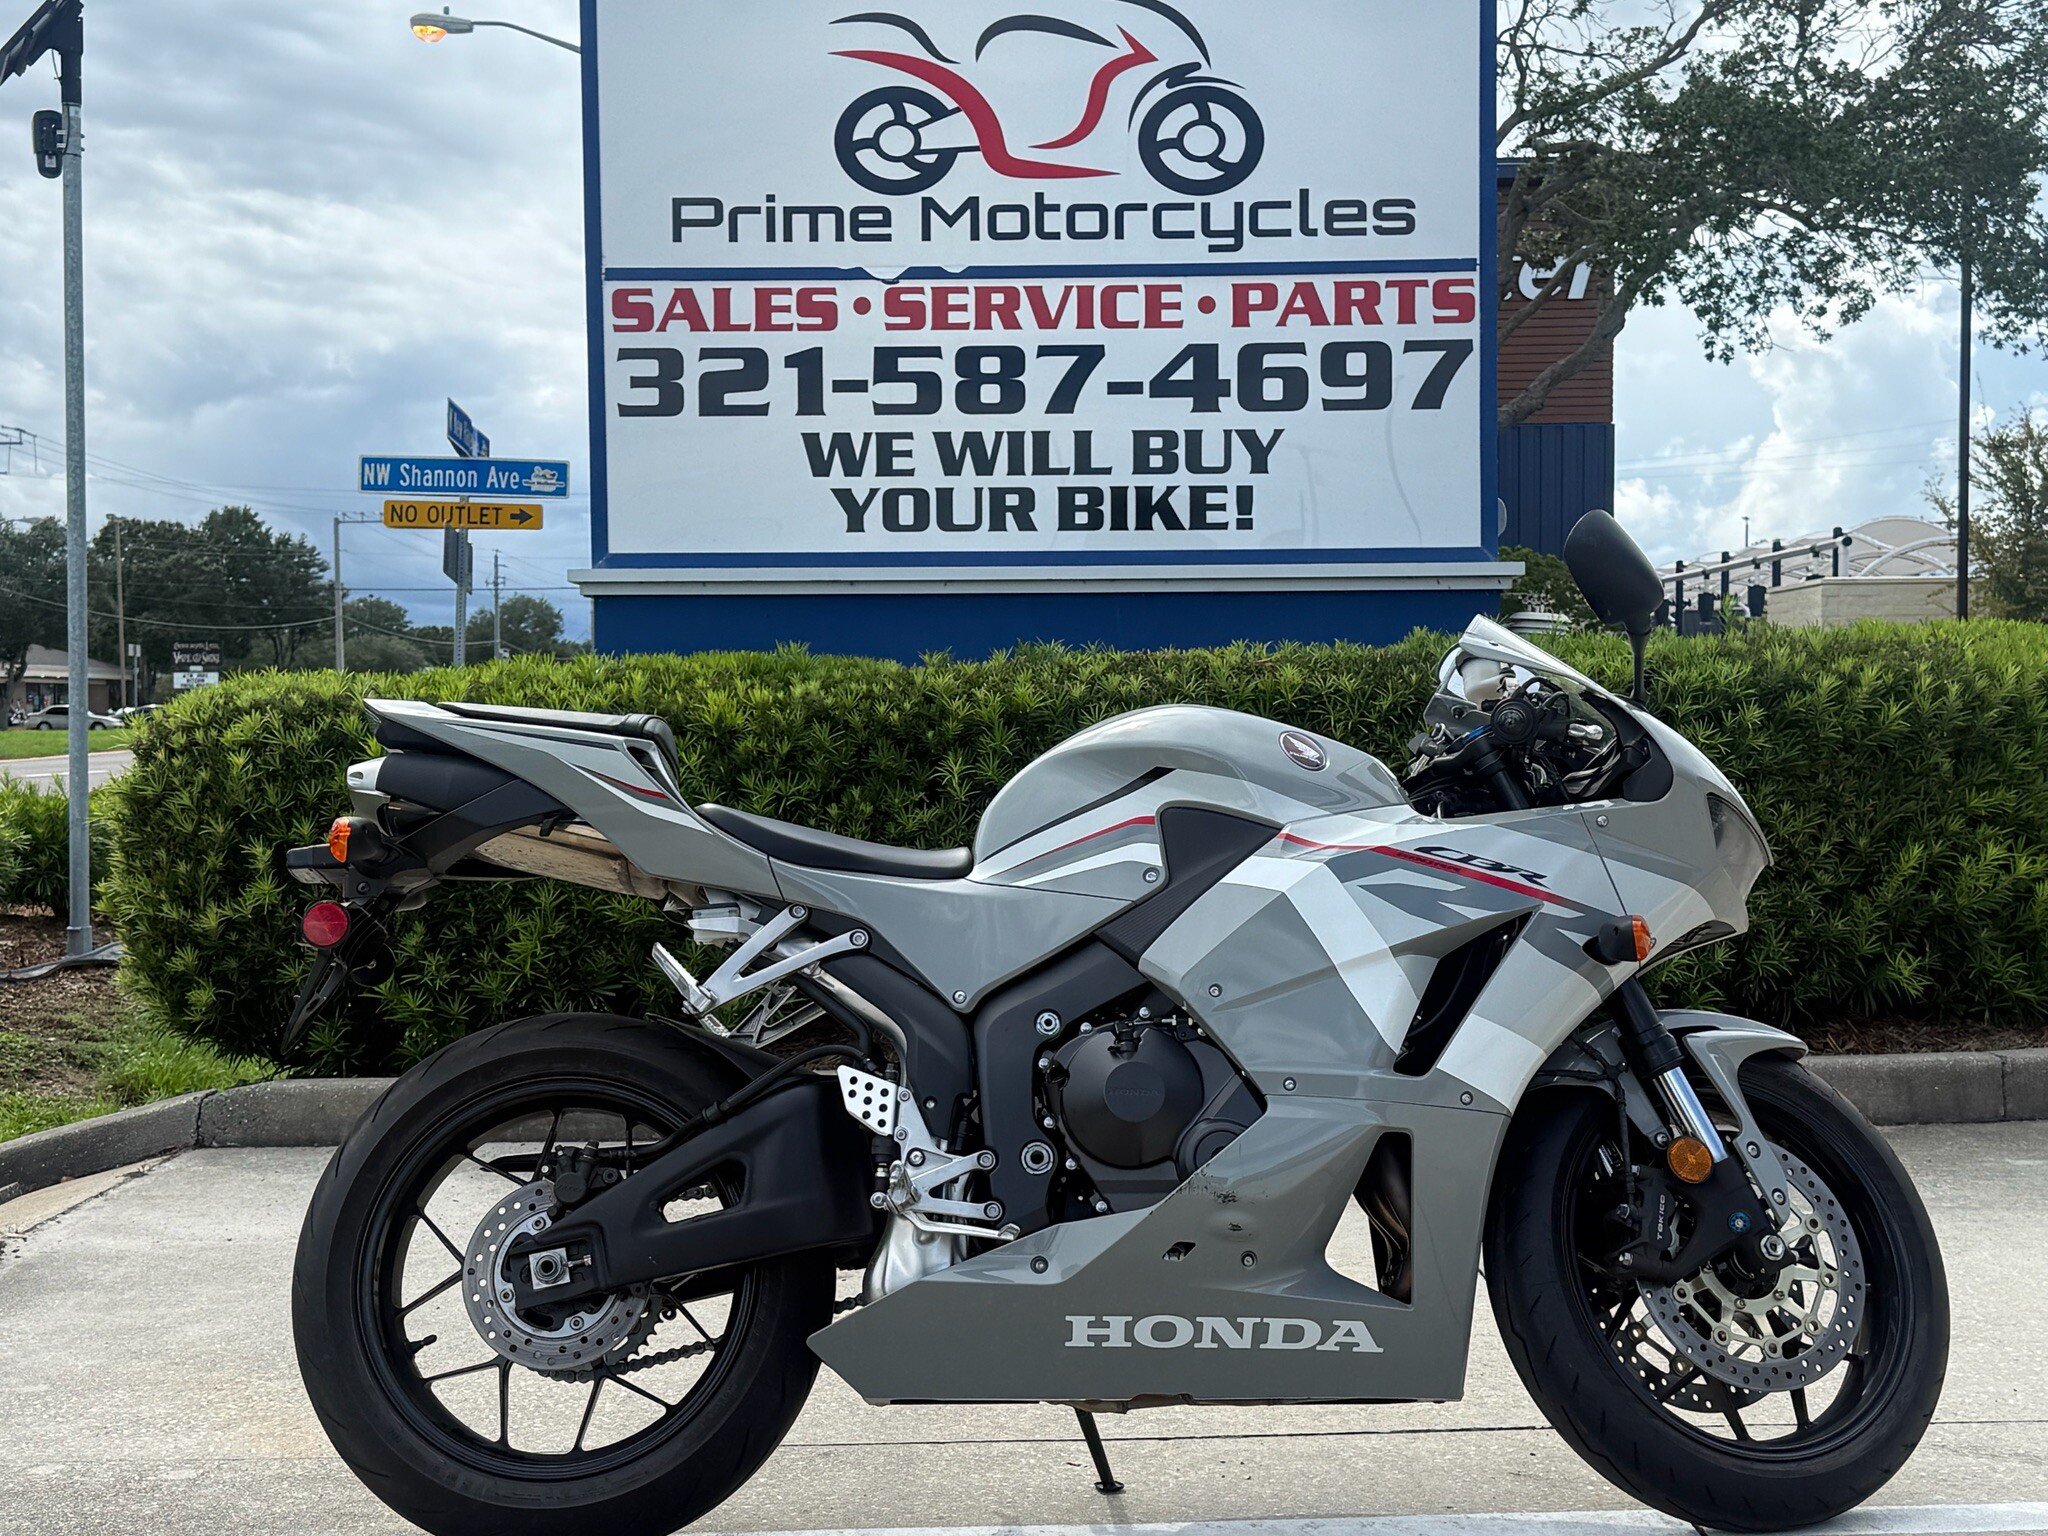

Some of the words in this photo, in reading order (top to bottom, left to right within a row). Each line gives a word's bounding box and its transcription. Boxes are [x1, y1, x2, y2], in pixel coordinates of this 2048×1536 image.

[672, 194, 892, 242] Prime
[920, 188, 1416, 253] Motorcycles
[613, 288, 838, 332] SALES
[884, 284, 1182, 331] SERVICE
[1232, 279, 1476, 327] PARTS
[616, 339, 1474, 418] 321-587-4697
[363, 463, 391, 486] NW
[399, 463, 478, 488] Shannon
[486, 465, 520, 489] Ave
[802, 432, 915, 478] WE
[933, 431, 1112, 477] WILL
[1132, 429, 1285, 475] BUY
[390, 504, 418, 523] NO
[426, 505, 504, 526] OUTLET
[831, 487, 1038, 533] YOUR
[1057, 485, 1254, 532] BIKE!
[1413, 846, 1550, 889] CBR
[1656, 1194, 1666, 1241] TOKICO
[1065, 1314, 1384, 1354] HONDA
